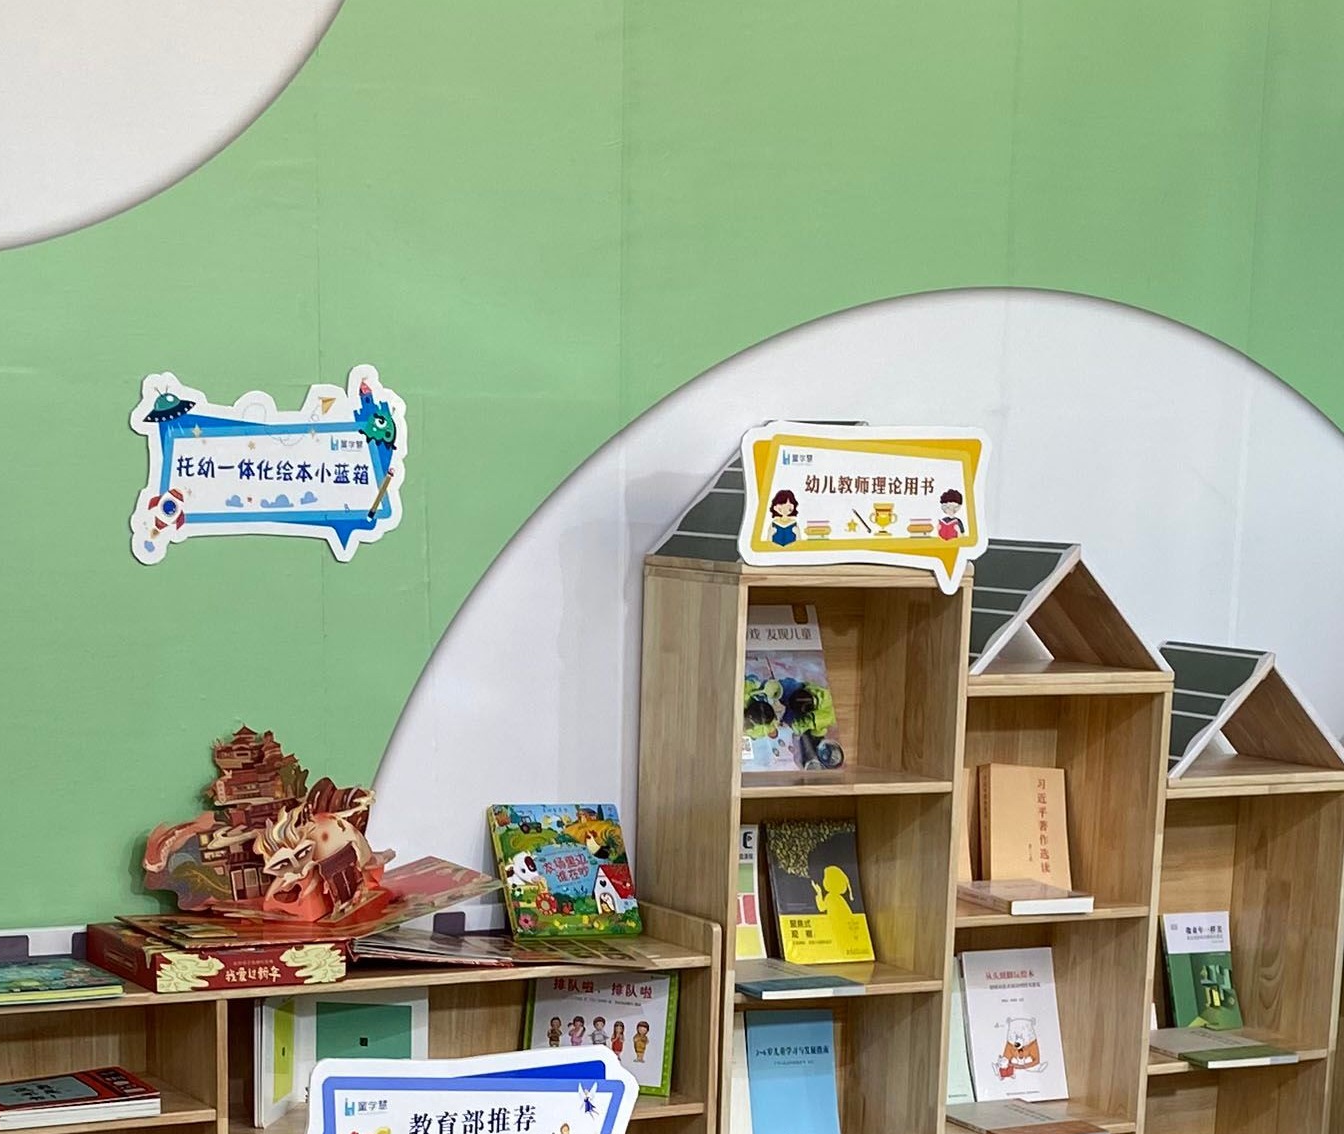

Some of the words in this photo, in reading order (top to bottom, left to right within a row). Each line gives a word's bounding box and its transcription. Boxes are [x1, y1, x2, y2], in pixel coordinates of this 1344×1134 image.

[176, 455, 370, 486] 托幼一体化绘本小蓝箱
[804, 474, 936, 496] 幼儿教师理论用书
[225, 966, 282, 983] 我爱过新年
